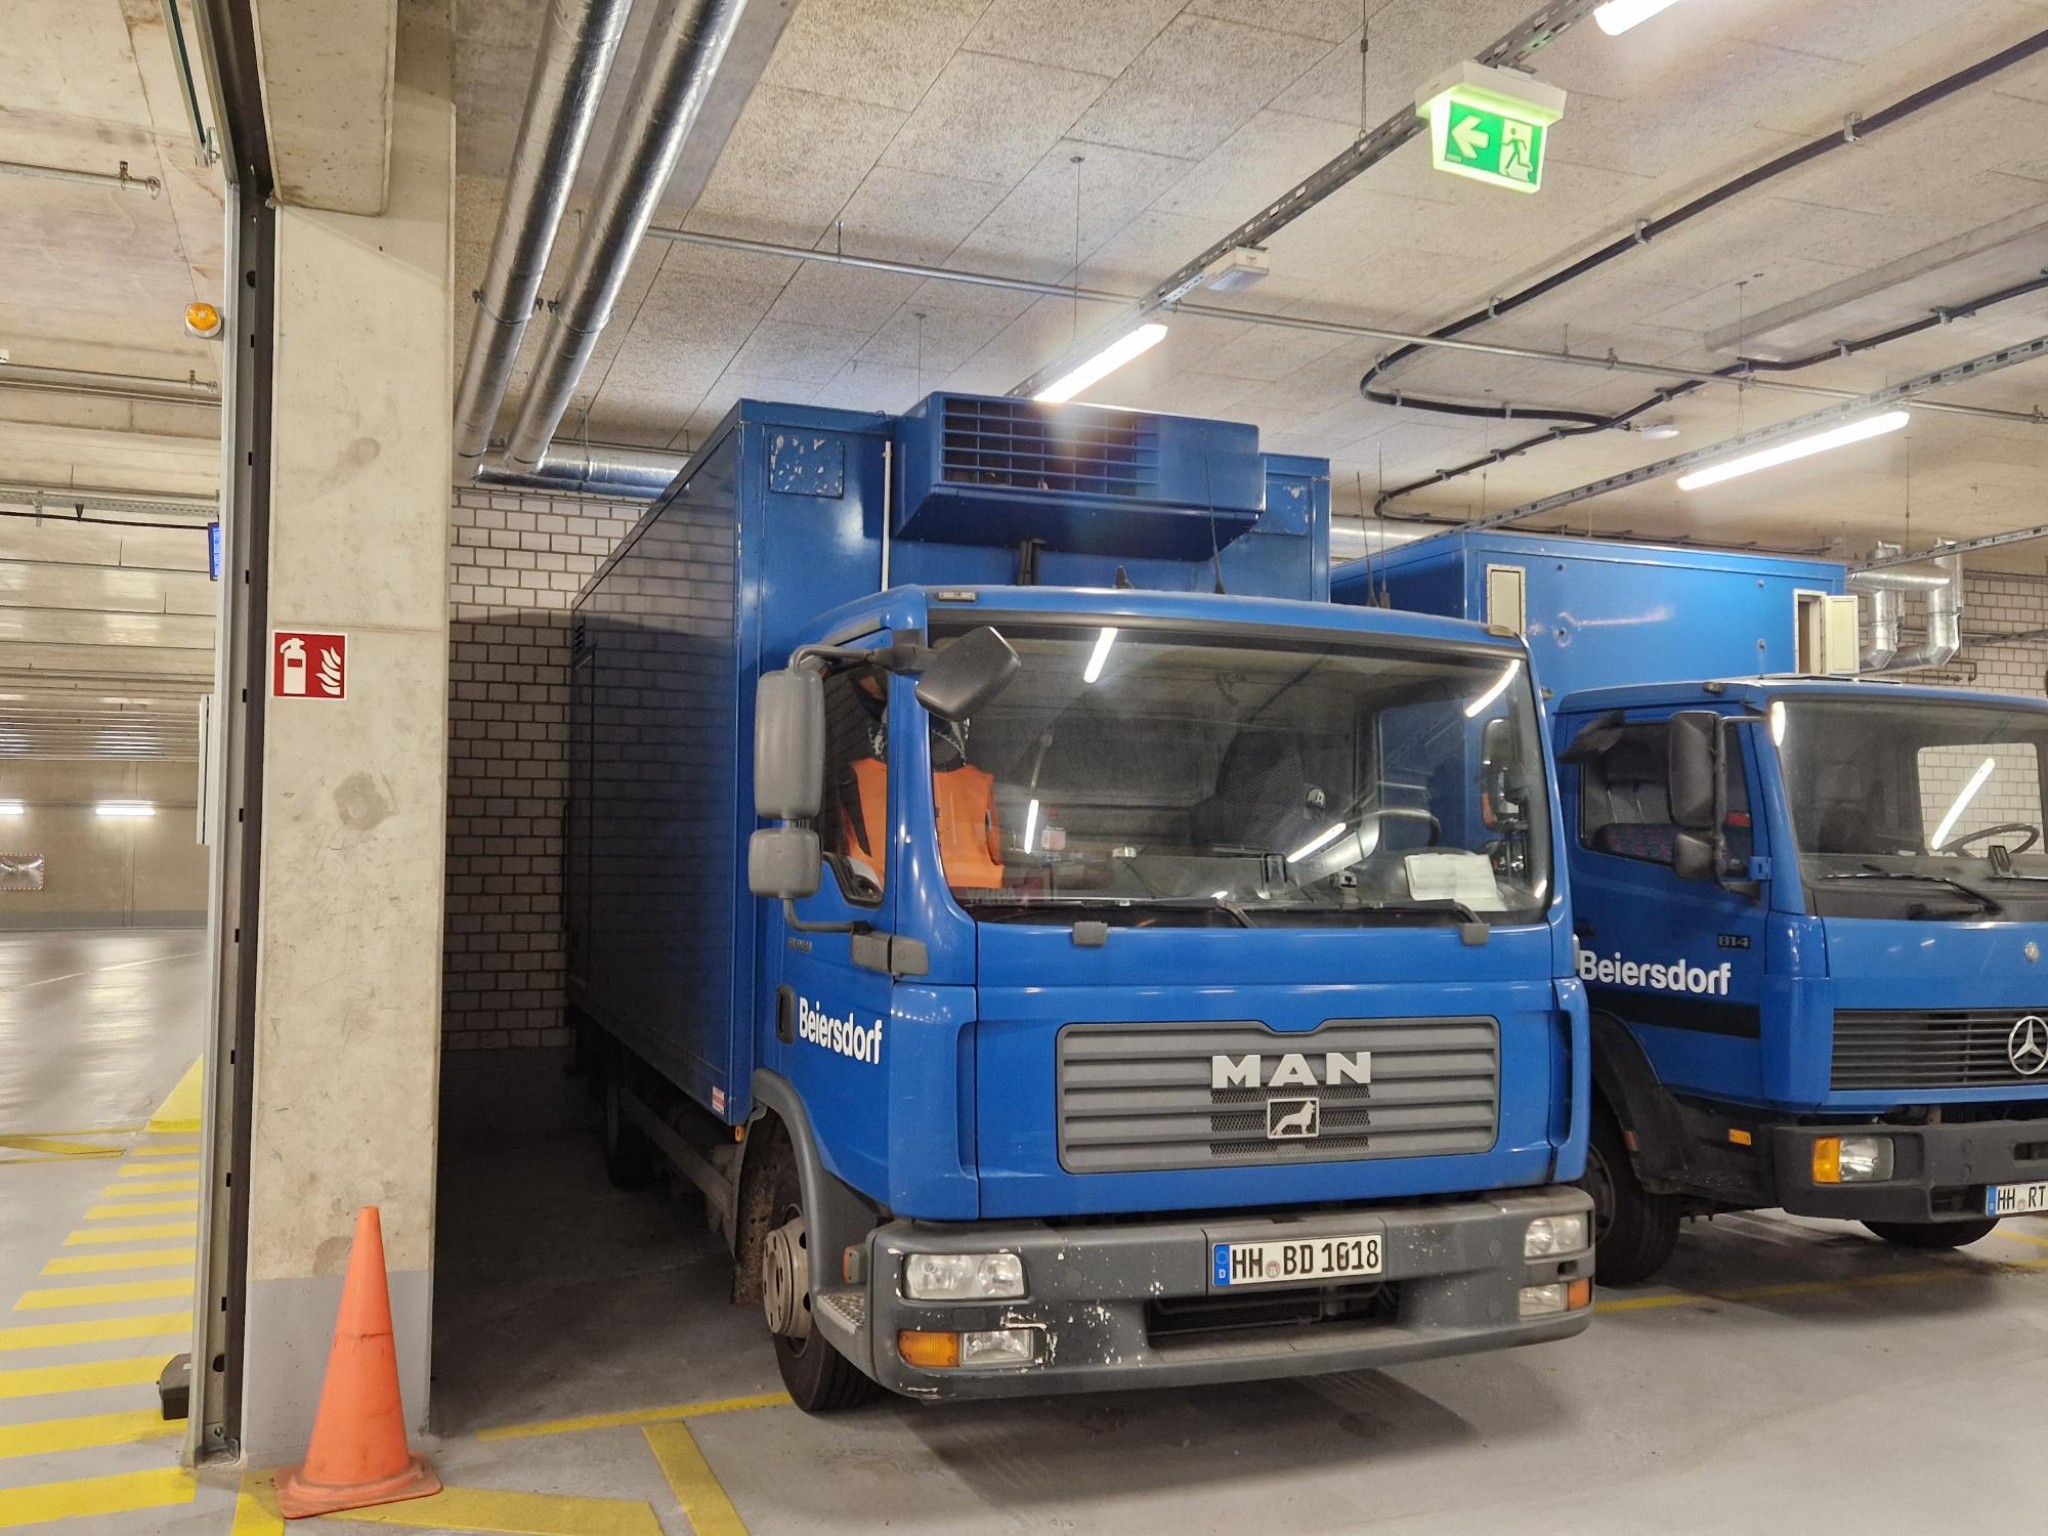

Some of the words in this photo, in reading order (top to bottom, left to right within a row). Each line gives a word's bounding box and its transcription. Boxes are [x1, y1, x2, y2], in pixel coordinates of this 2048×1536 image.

[1579, 949, 1732, 995] Beiersdorf
[799, 996, 882, 1065] Beiersdorf
[1211, 1051, 1371, 1089] MAN
[1997, 1188, 2016, 1211] HH
[2028, 1185, 2047, 1208] RT
[1218, 1270, 1226, 1279] D
[1232, 1247, 1263, 1279] HH
[1283, 1244, 1314, 1275] BD
[1321, 1239, 1379, 1273] 1018
